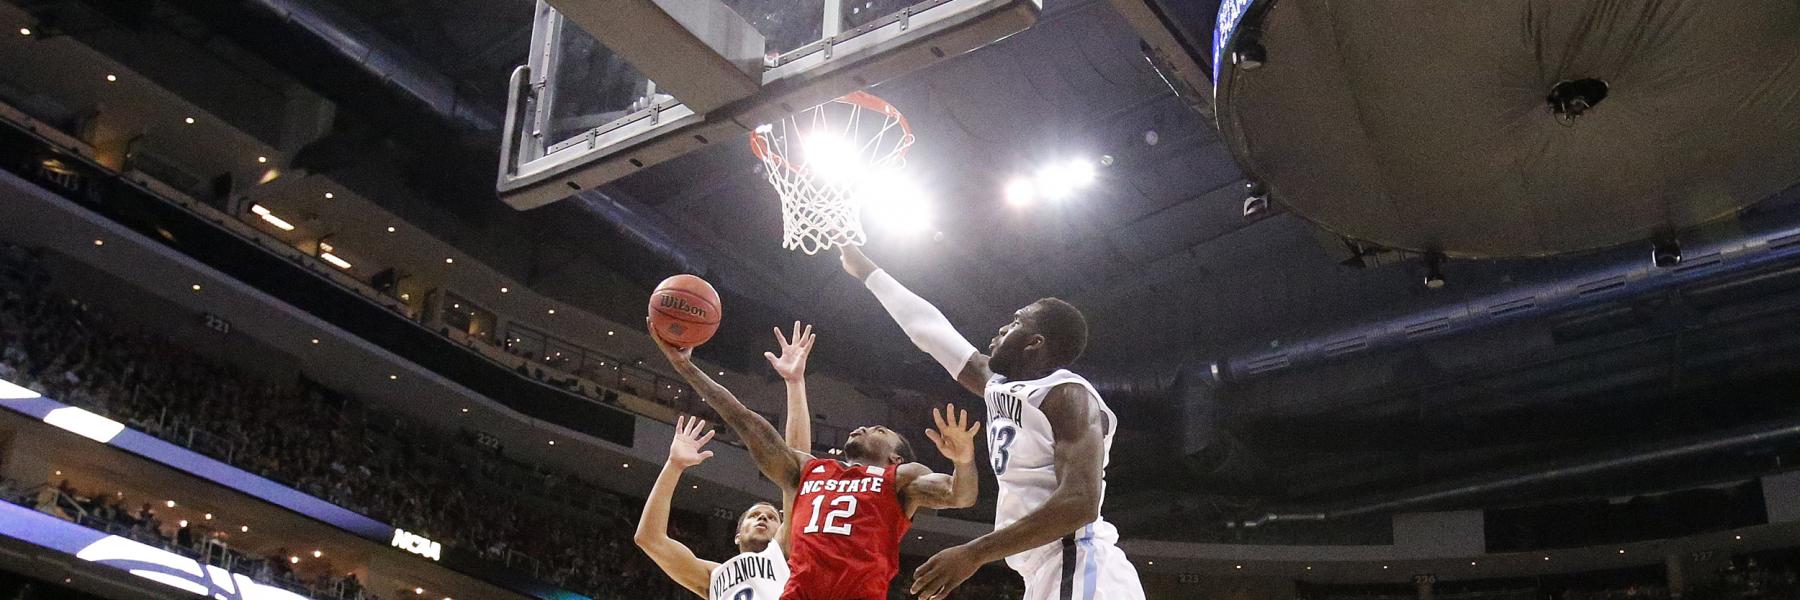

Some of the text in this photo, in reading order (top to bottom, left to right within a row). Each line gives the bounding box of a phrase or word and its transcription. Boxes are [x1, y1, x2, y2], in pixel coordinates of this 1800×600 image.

[661, 295, 706, 318] Wilson
[206, 315, 230, 333] 221
[478, 433, 498, 448] 222
[800, 477, 884, 496] NC STATE
[803, 494, 858, 536] 12
[713, 556, 776, 600] VILLANOVA
